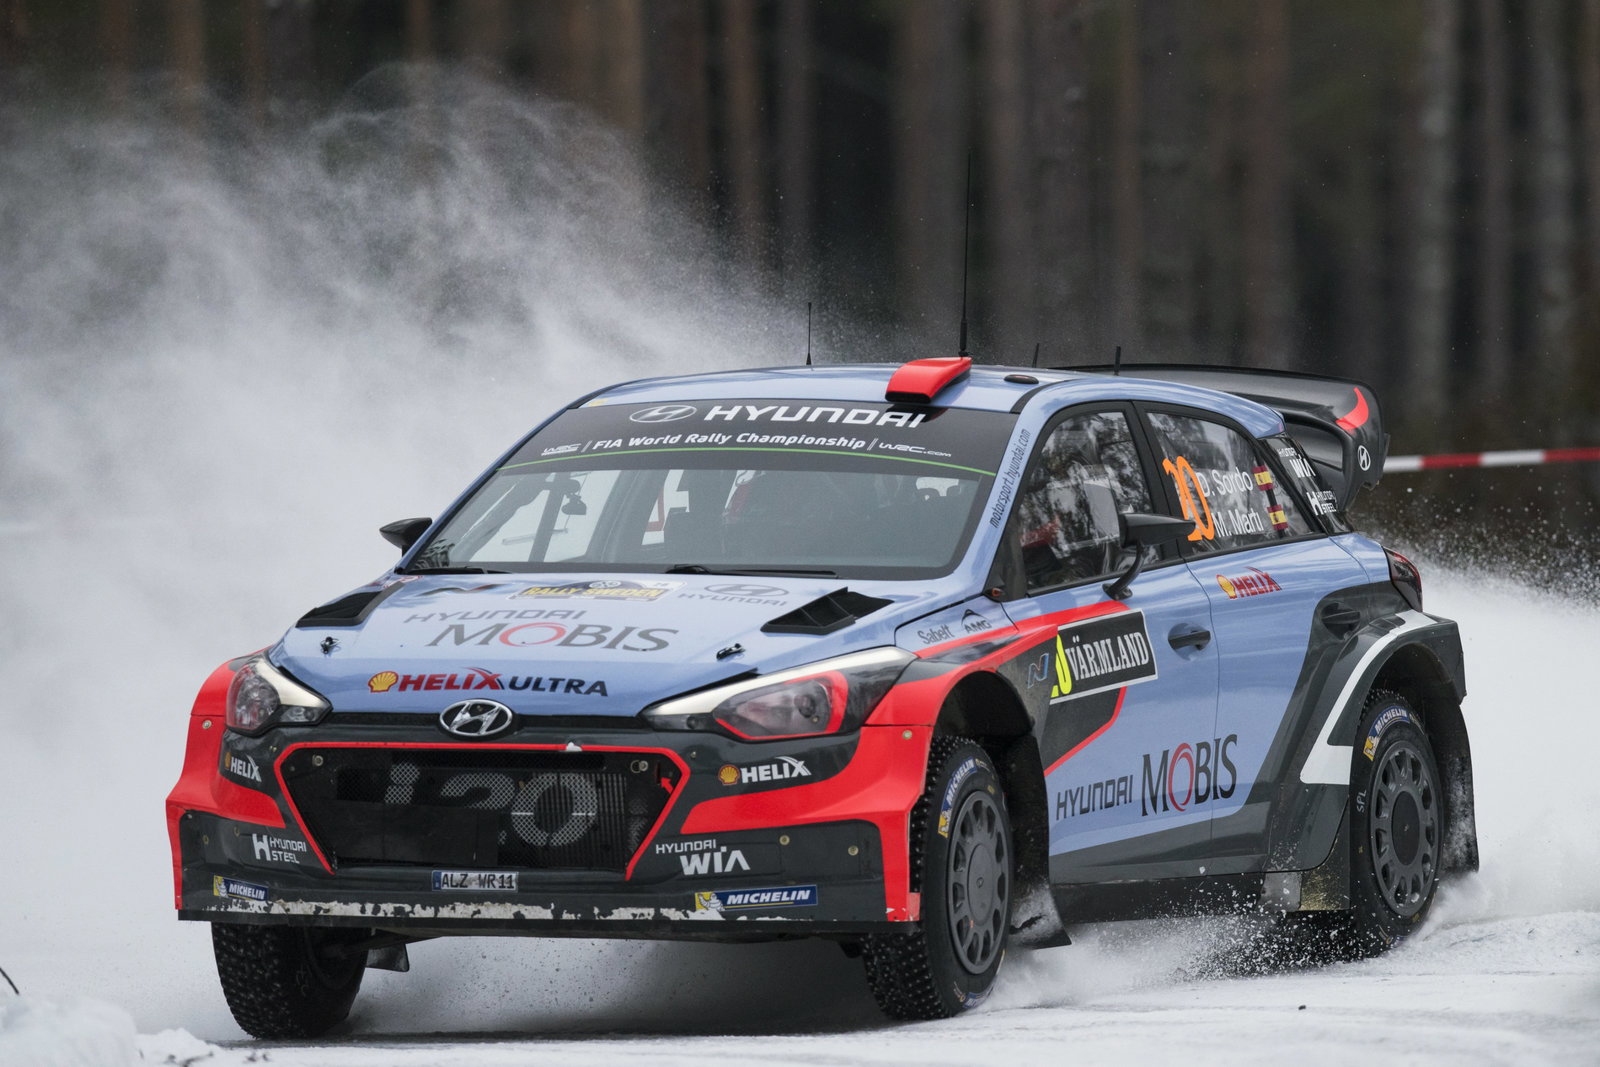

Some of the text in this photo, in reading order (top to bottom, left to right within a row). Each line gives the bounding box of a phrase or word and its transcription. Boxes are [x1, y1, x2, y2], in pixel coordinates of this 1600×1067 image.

[703, 405, 926, 428] HYUNDAI
[592, 432, 866, 450] FIA World Rally Championship
[990, 428, 1031, 529] motorsport.hyundai.com
[1212, 466, 1254, 496] Sordo
[1162, 455, 1215, 541] 10
[1211, 511, 1233, 538] M.
[522, 587, 665, 597] RALLY SWEDEN
[1233, 566, 1282, 598] HELIX
[677, 592, 788, 606] HYUNDAI
[403, 609, 587, 623] HYUNDAI
[424, 621, 679, 651] MOBIS
[917, 623, 955, 645] Sabelt
[1065, 635, 1150, 681] VÄRMLAND
[399, 667, 609, 697] HELIX ULTRA
[1374, 708, 1407, 733] MICHELIN
[231, 755, 262, 782] HELIX
[740, 756, 812, 784] HELIX
[1141, 734, 1238, 817] MOBIS
[945, 758, 975, 806] MICHELIN
[1056, 774, 1134, 821] HYUNDAI
[269, 837, 307, 852] HYUNDAI
[272, 850, 300, 864] STEEL
[655, 839, 717, 855] HYUNDAI
[228, 883, 266, 900] MICHELIN
[442, 873, 468, 888] ALZ
[726, 889, 811, 905] MICHELIN
